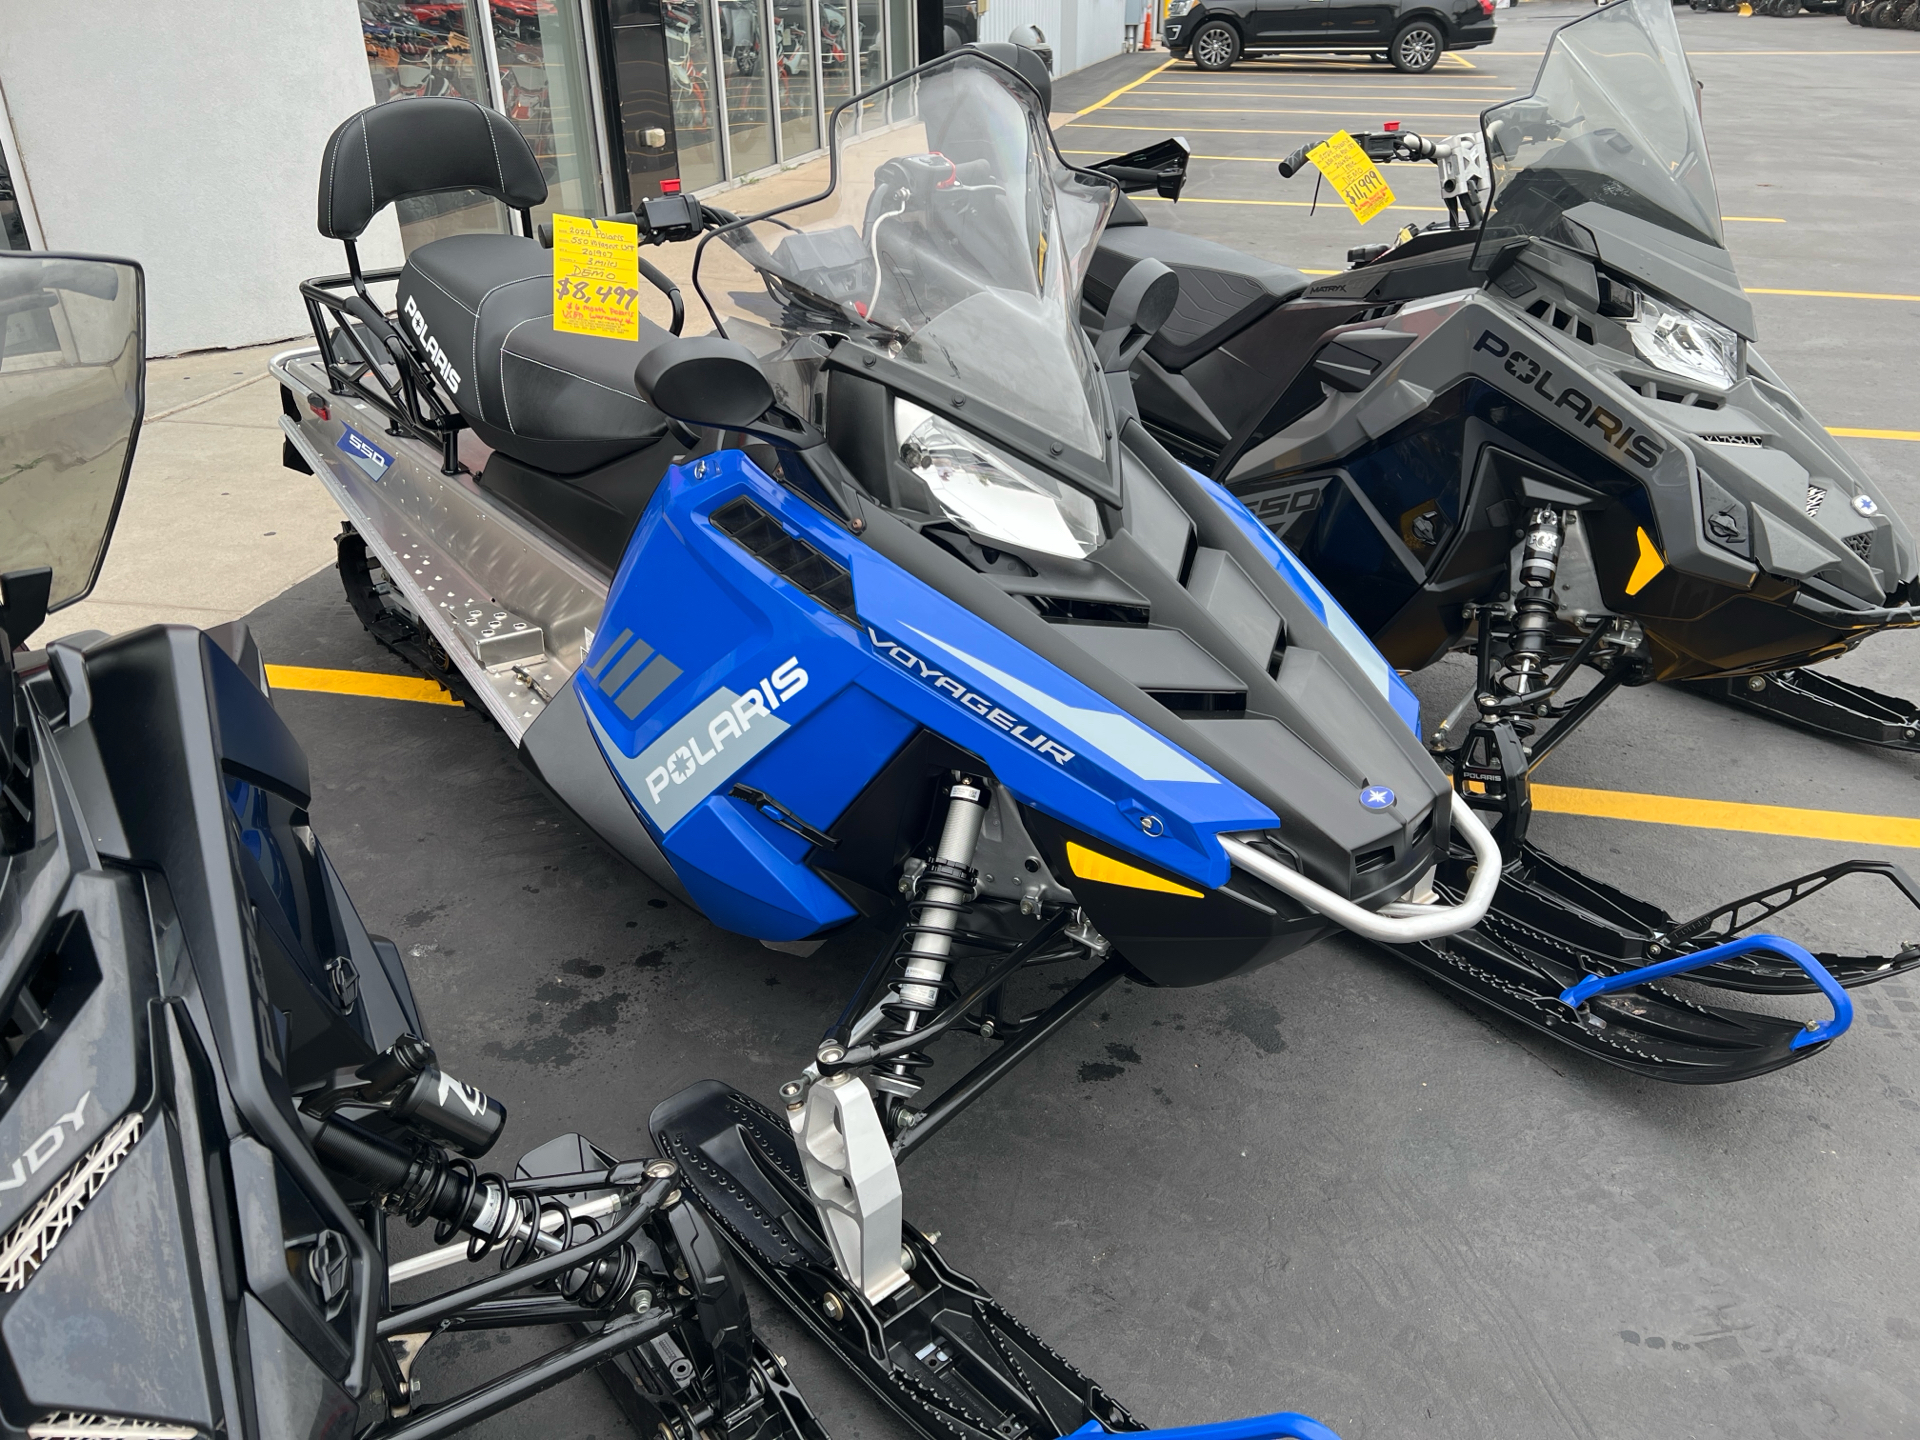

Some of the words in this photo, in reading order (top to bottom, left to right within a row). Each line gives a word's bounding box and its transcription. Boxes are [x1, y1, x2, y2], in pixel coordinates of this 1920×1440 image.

[1345, 170, 1382, 207] $11,999
[569, 227, 591, 238] 2024
[571, 237, 589, 245] 550
[582, 248, 613, 258] 201907
[572, 264, 616, 280] DEMO
[556, 277, 639, 311] $8,499
[1310, 284, 1347, 294] MATRYX
[404, 295, 462, 394] POLARIS
[1473, 329, 1666, 469] POLARIS
[349, 433, 385, 468] 550
[1529, 530, 1559, 553] FOX
[868, 626, 1076, 766] VOYAGEUR
[645, 656, 809, 805] POLARIS
[1463, 771, 1502, 782] POLARIS
